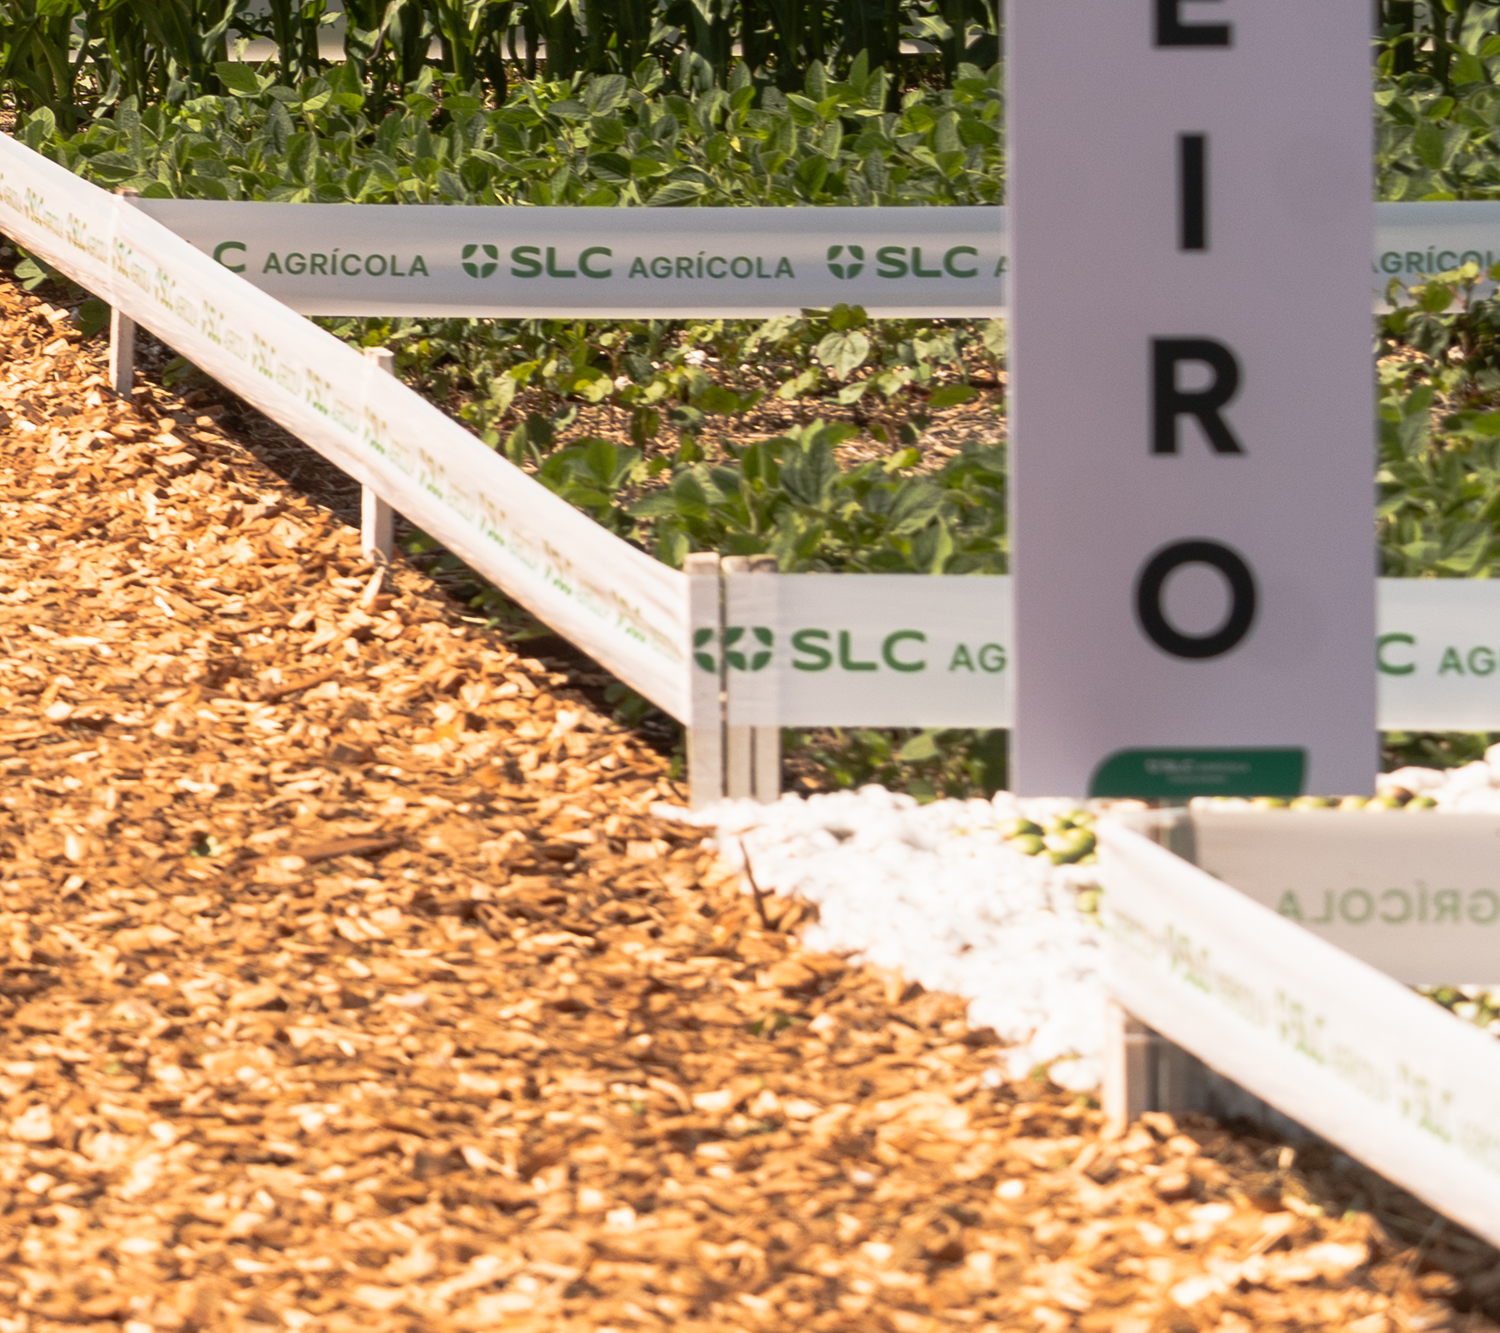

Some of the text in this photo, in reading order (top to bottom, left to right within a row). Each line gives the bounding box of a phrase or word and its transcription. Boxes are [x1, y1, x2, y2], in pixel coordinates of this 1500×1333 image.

[262, 247, 430, 277] AGRÍCOLA
[510, 244, 795, 280] SLC AGRÍCOLA
[875, 245, 978, 278] SLC
[790, 629, 927, 673] SLC
